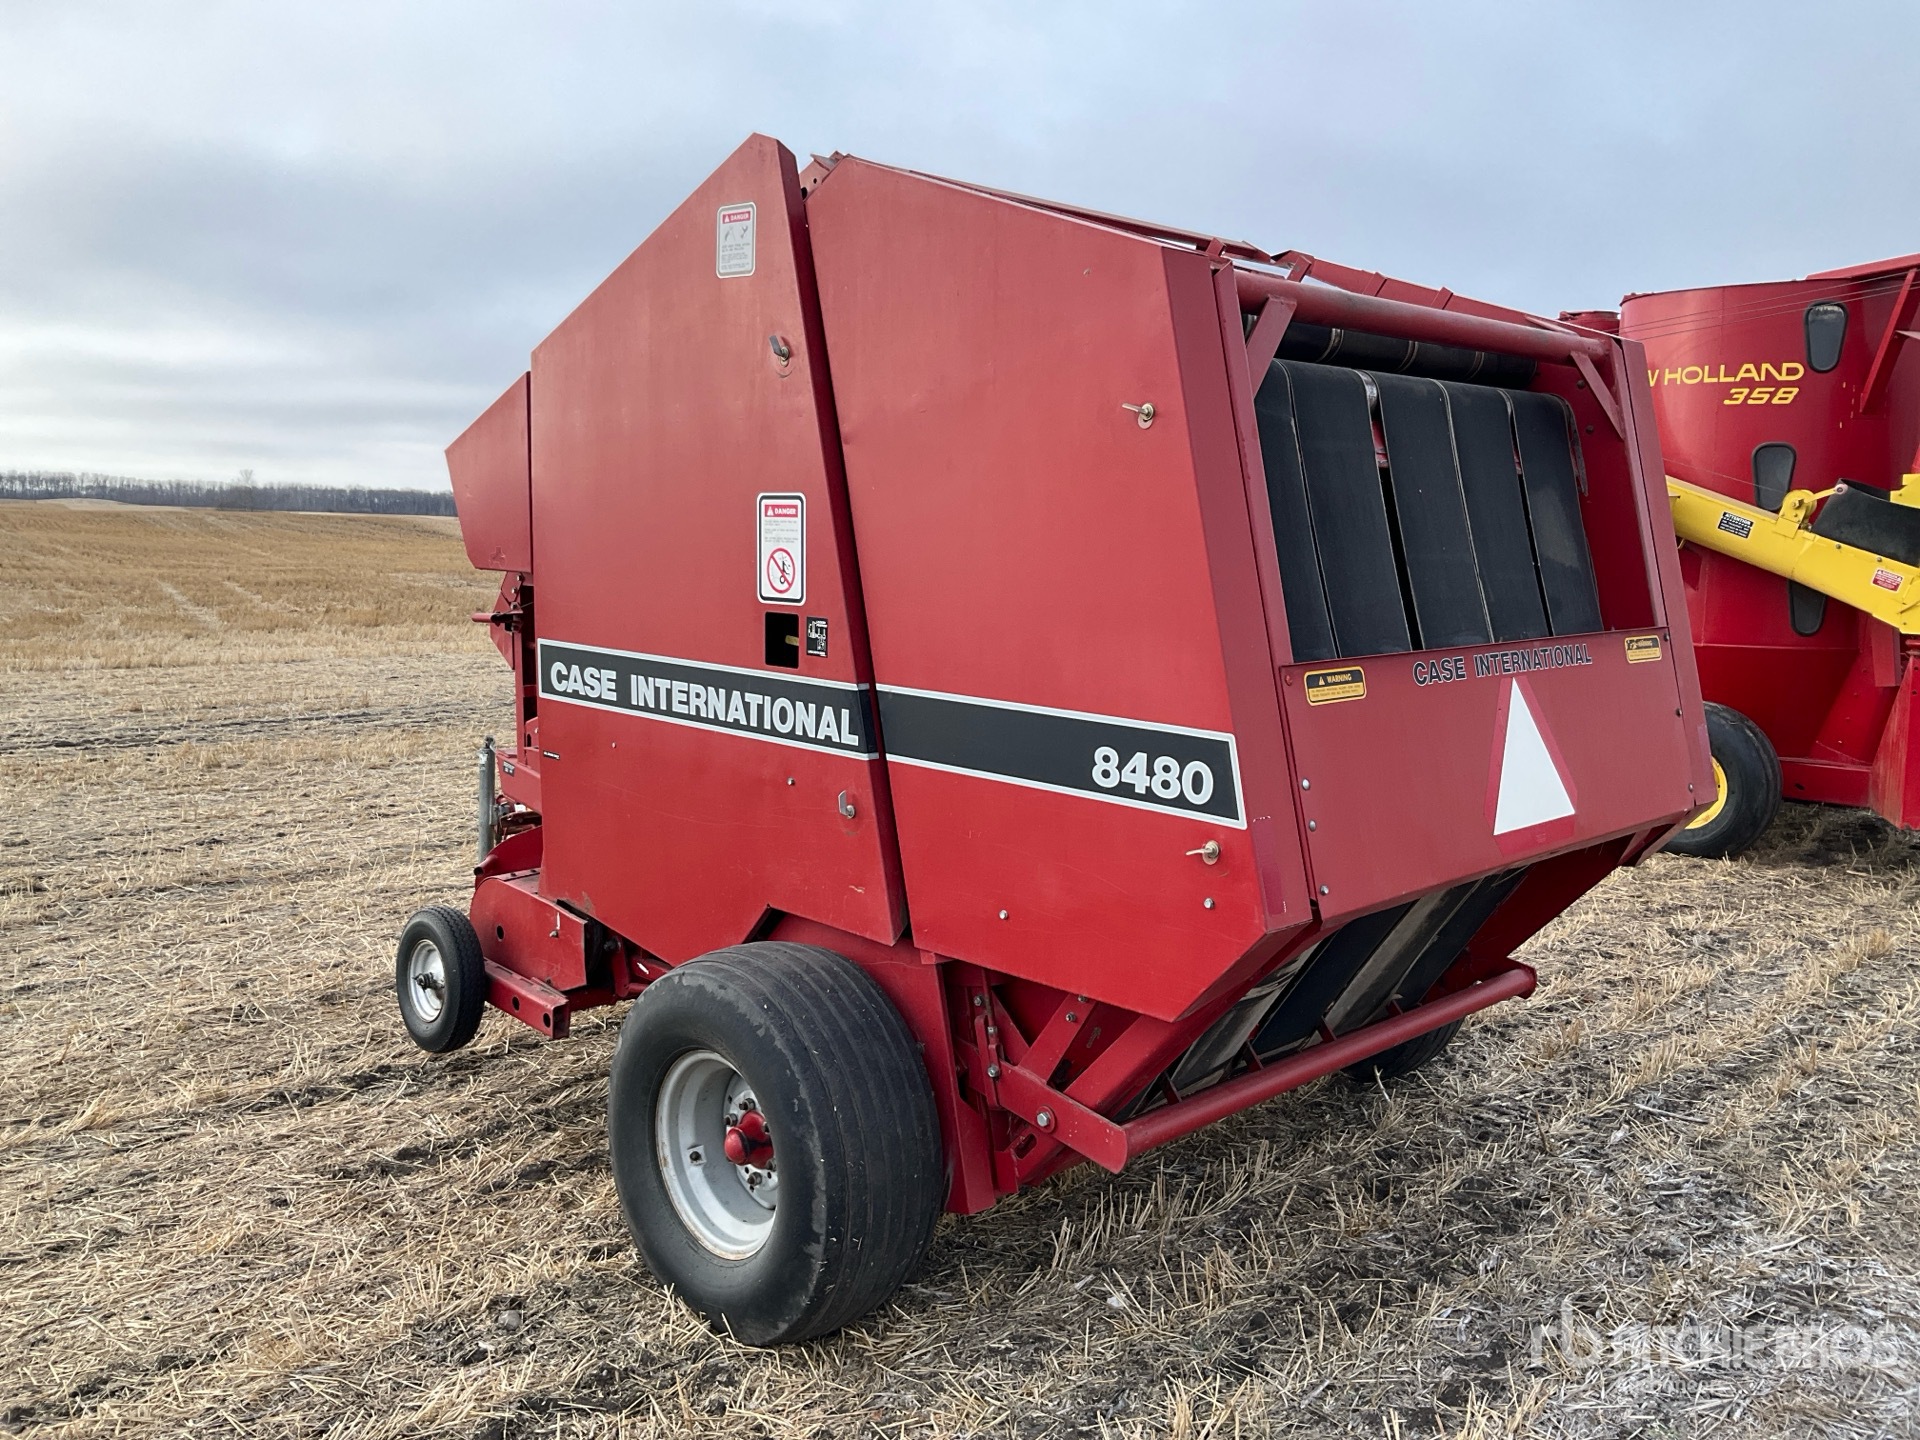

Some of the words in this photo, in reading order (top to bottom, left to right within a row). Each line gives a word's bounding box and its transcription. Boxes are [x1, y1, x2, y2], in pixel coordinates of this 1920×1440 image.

[731, 213, 749, 221] DANGER
[1664, 362, 1805, 385] HOLLAND
[1723, 387, 1800, 405] 358
[1413, 656, 1467, 686] CASE
[1473, 644, 1593, 678] INTERNATIONAL
[1326, 673, 1352, 684] WARNING
[550, 661, 617, 701] CASE
[630, 674, 860, 746] INTERNATIONAL
[1091, 746, 1214, 805] 8480
